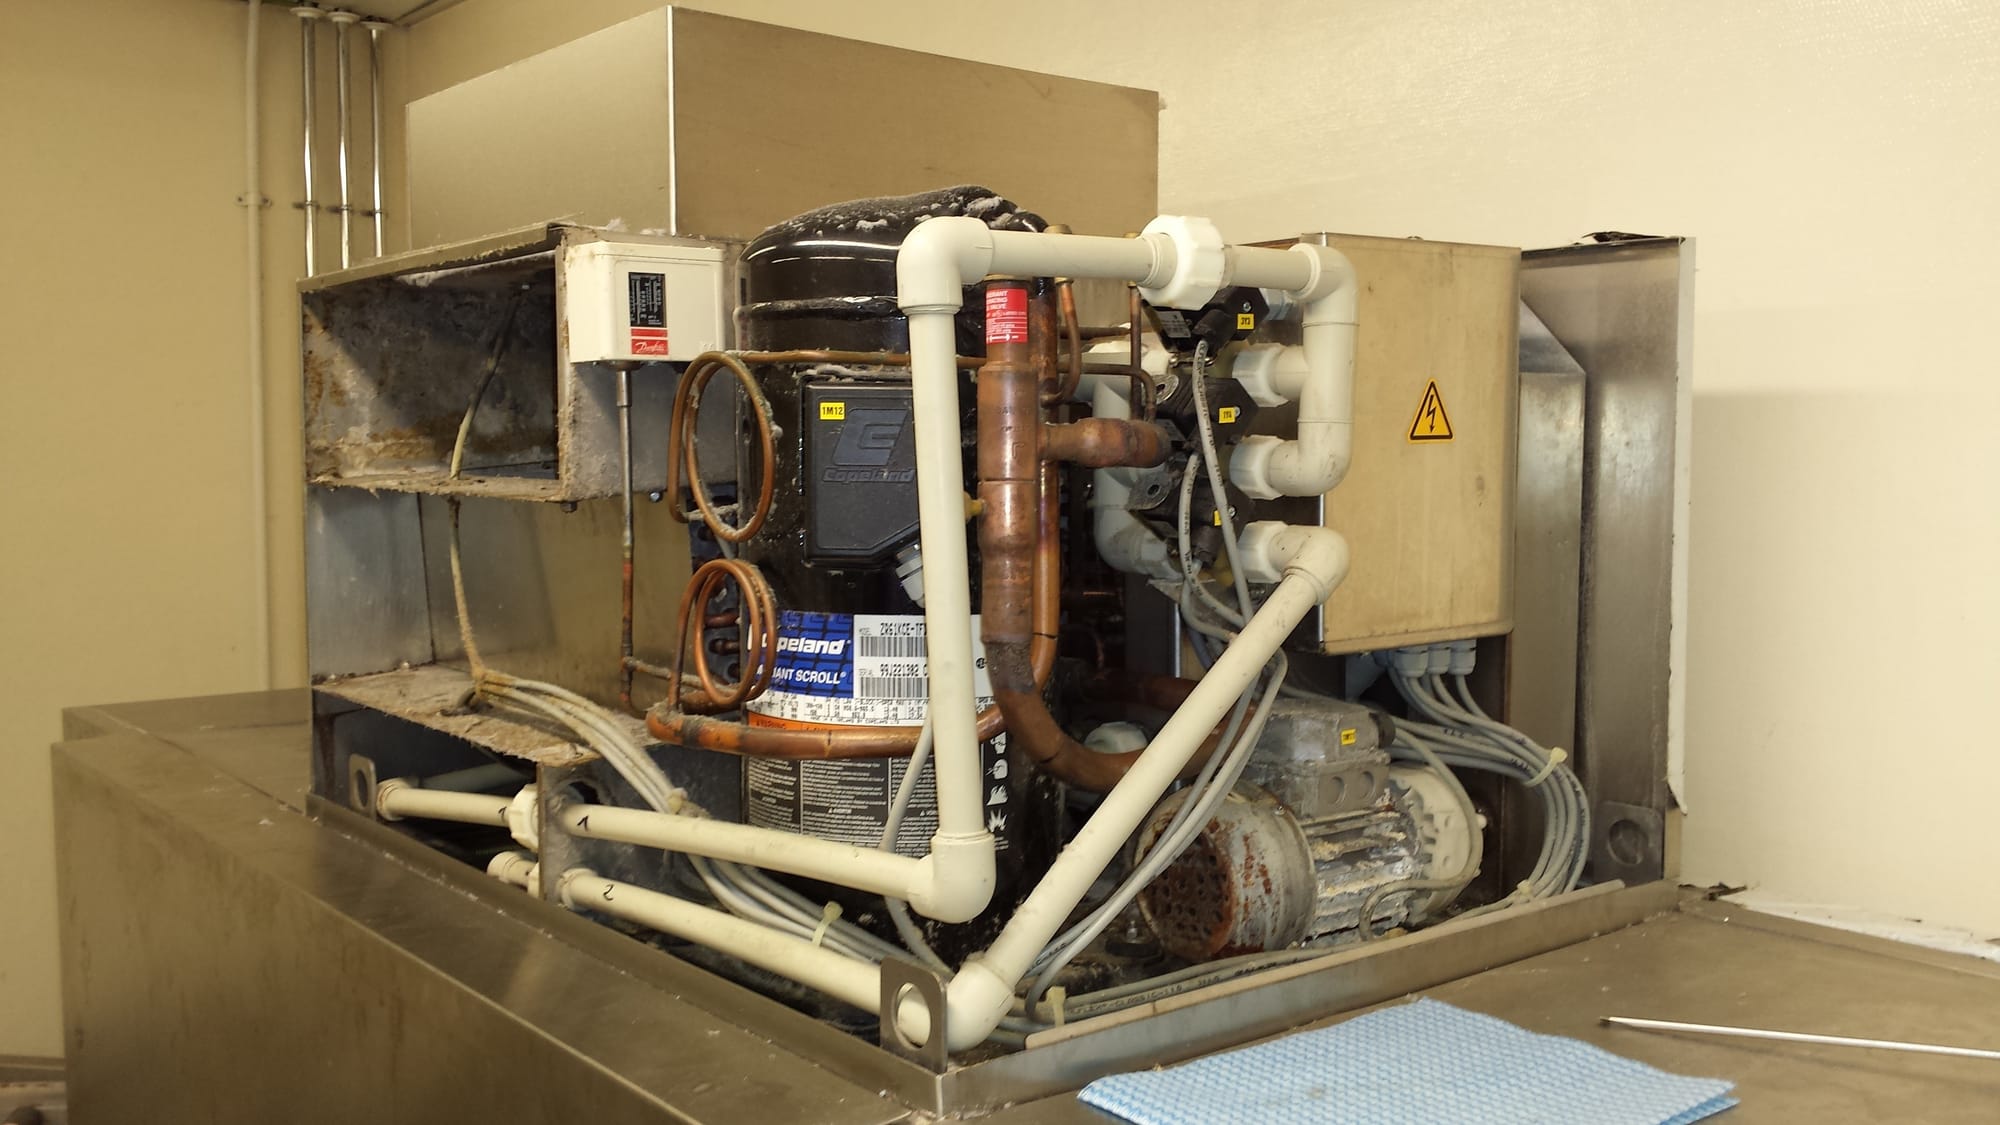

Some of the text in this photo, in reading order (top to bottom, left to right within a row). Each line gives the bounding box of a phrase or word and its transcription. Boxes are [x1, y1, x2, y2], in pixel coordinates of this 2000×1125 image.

[822, 406, 843, 415] 1M12
[822, 467, 915, 484] Copeland
[747, 624, 846, 655] peland
[795, 669, 842, 686] SCROLL
[577, 815, 590, 831] 1
[603, 884, 614, 901] 2
